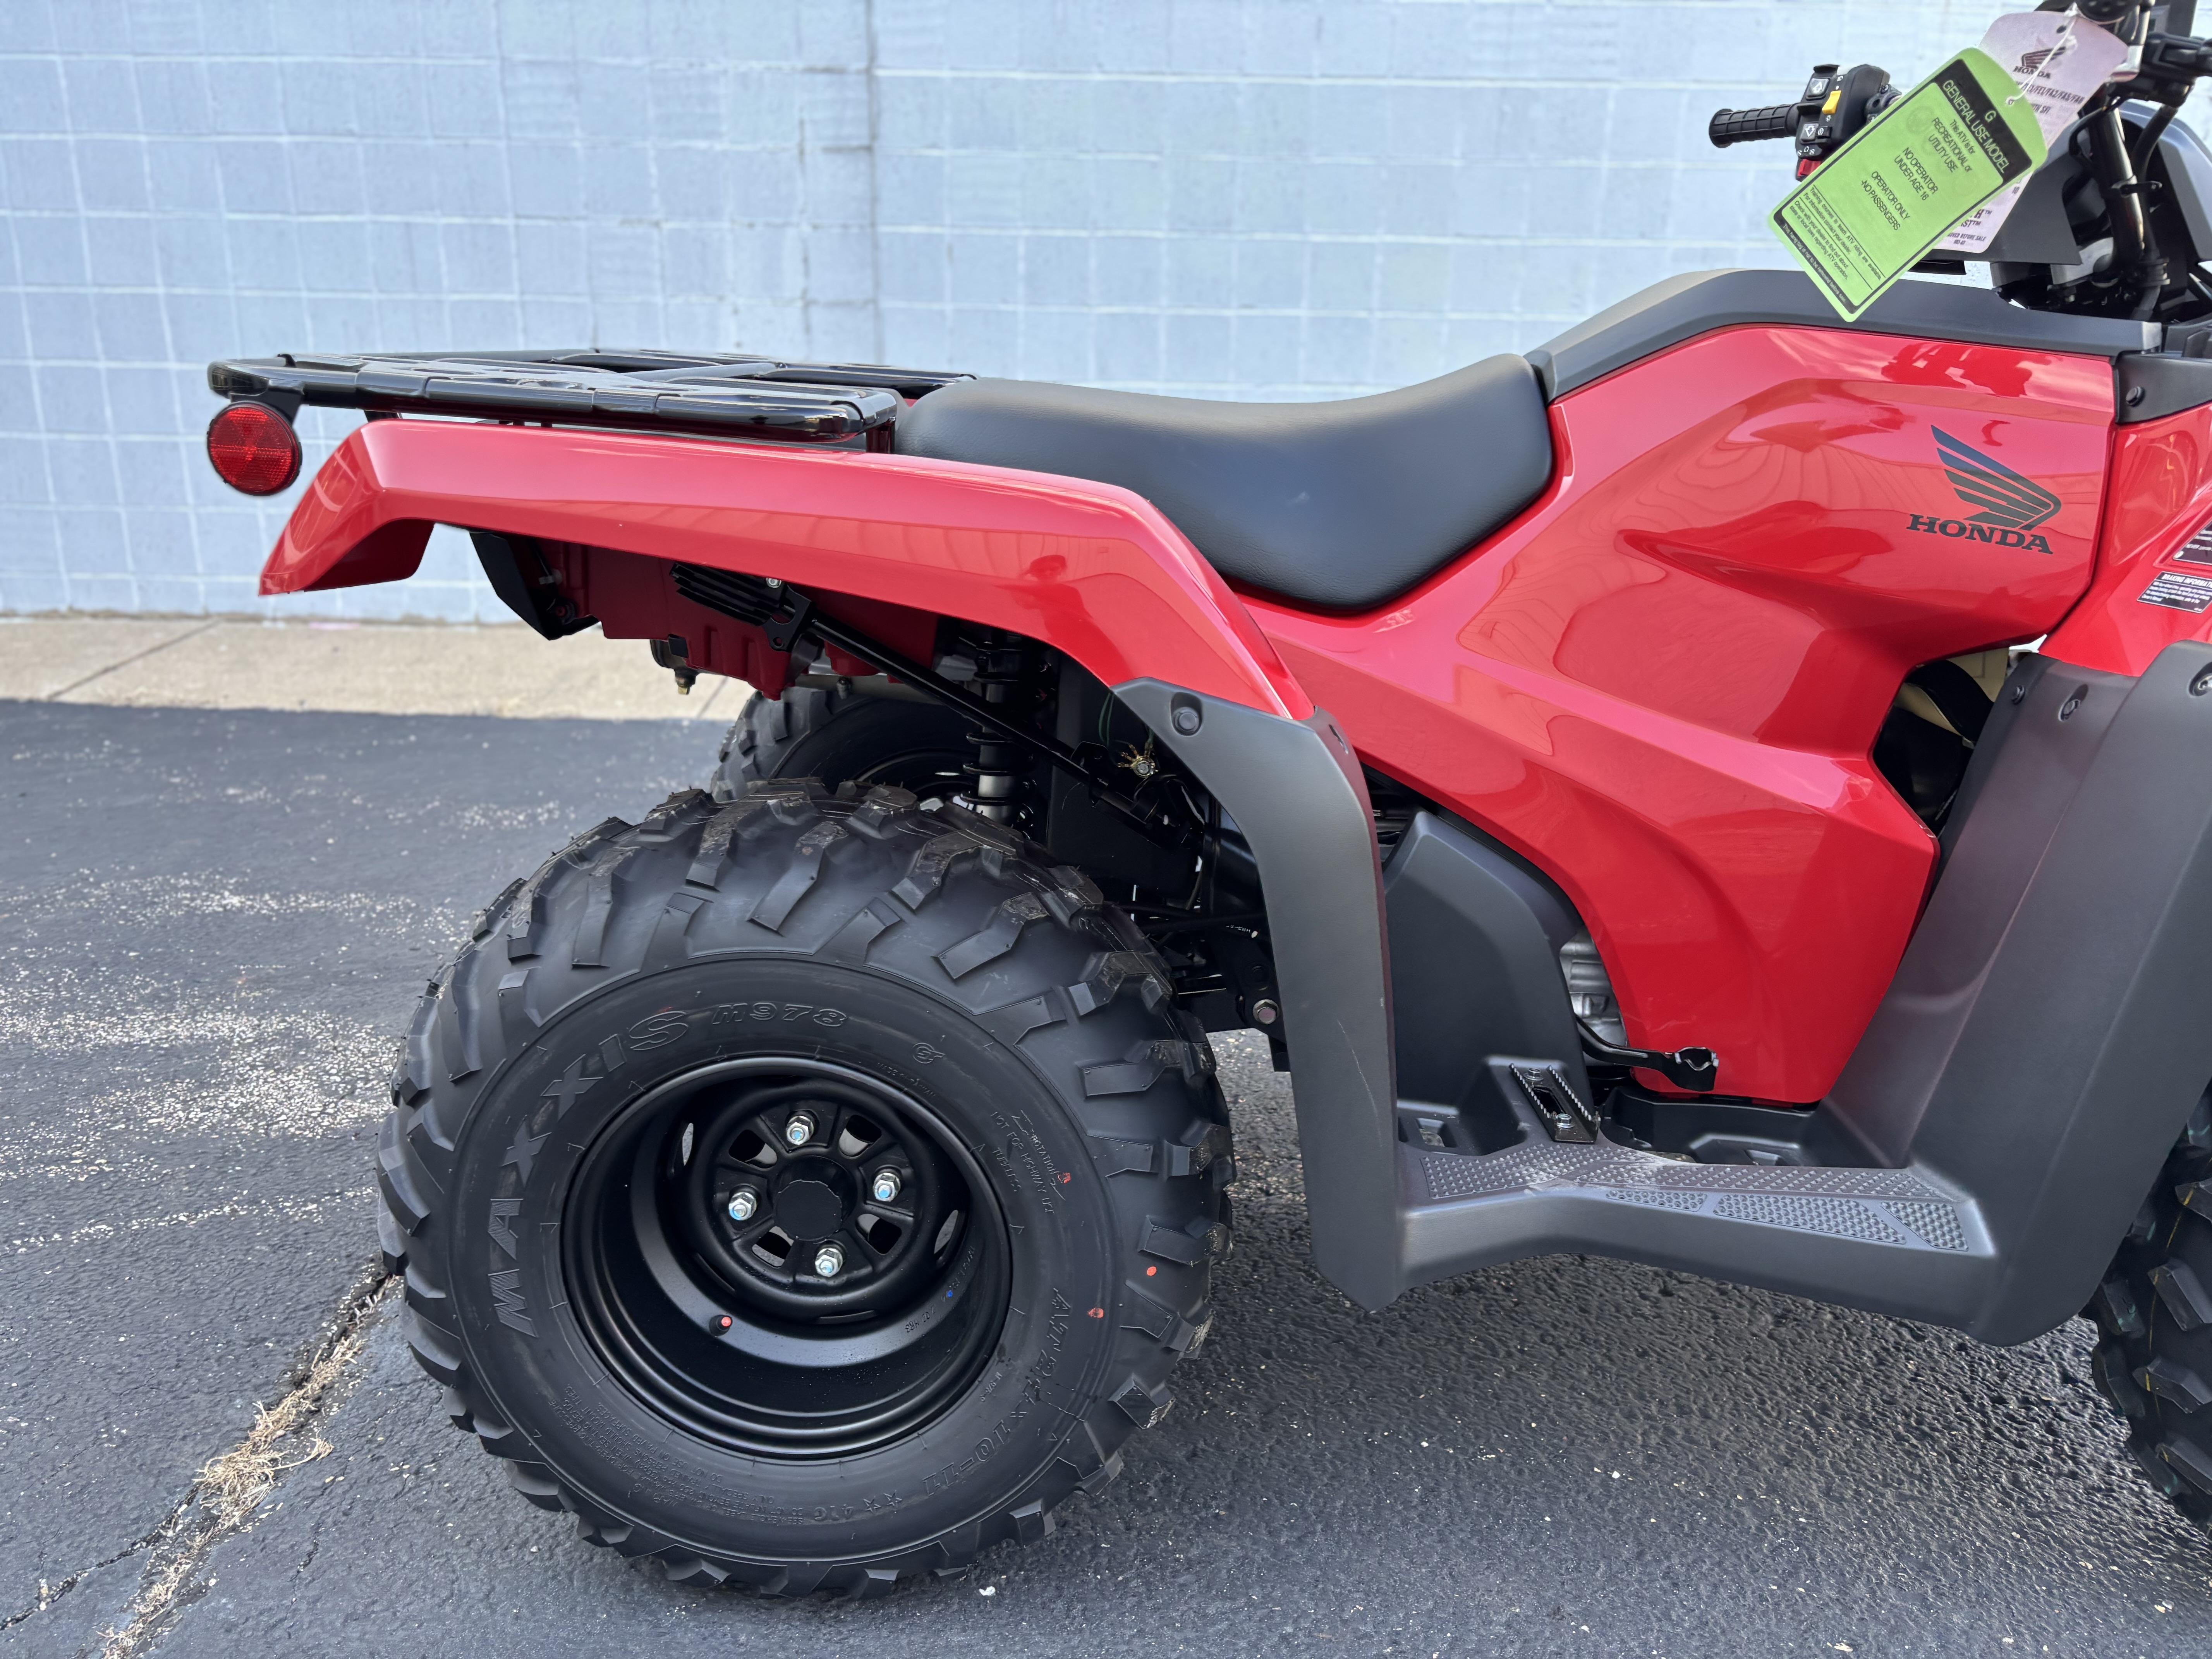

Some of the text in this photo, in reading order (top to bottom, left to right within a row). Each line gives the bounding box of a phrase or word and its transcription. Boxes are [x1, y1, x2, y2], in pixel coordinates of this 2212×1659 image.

[1942, 79, 2009, 173] GENERAL USE MODEL
[1949, 118, 1959, 132] This
[1956, 131, 1969, 143] ATV
[1967, 146, 1975, 154] for
[1984, 110, 1996, 122] G
[1928, 134, 1958, 173] UTILITY USE
[1931, 117, 1968, 167] RECREATIONAL
[1894, 155, 1929, 201] UNDER AGE 16
[1902, 147, 1938, 194] NO OPERATOR
[1810, 187, 1822, 204] Training
[1846, 235, 1855, 244] ATV
[1868, 189, 1900, 230] PASSENGERS
[1871, 171, 1910, 220] OPERATOR ONLY
[1794, 200, 1805, 214] Check
[1808, 220, 1818, 229] your
[1816, 228, 1826, 241] dealer
[1828, 243, 1836, 252] find
[1800, 218, 1810, 228] local
[1814, 236, 1829, 255] regarding
[1827, 253, 1836, 262] ATV
[1824, 219, 1836, 234] contact
[1833, 232, 1843, 242] your
[1906, 514, 2053, 554] HONDA
[711, 1001, 850, 1027] M978
[487, 1010, 689, 1338] MAXXIS
[989, 1109, 1010, 1132] NOT
[1006, 1130, 1025, 1152] FOR
[1020, 1151, 1048, 1195] HIGHWAY
[992, 1146, 1022, 1193] TUBELESS
